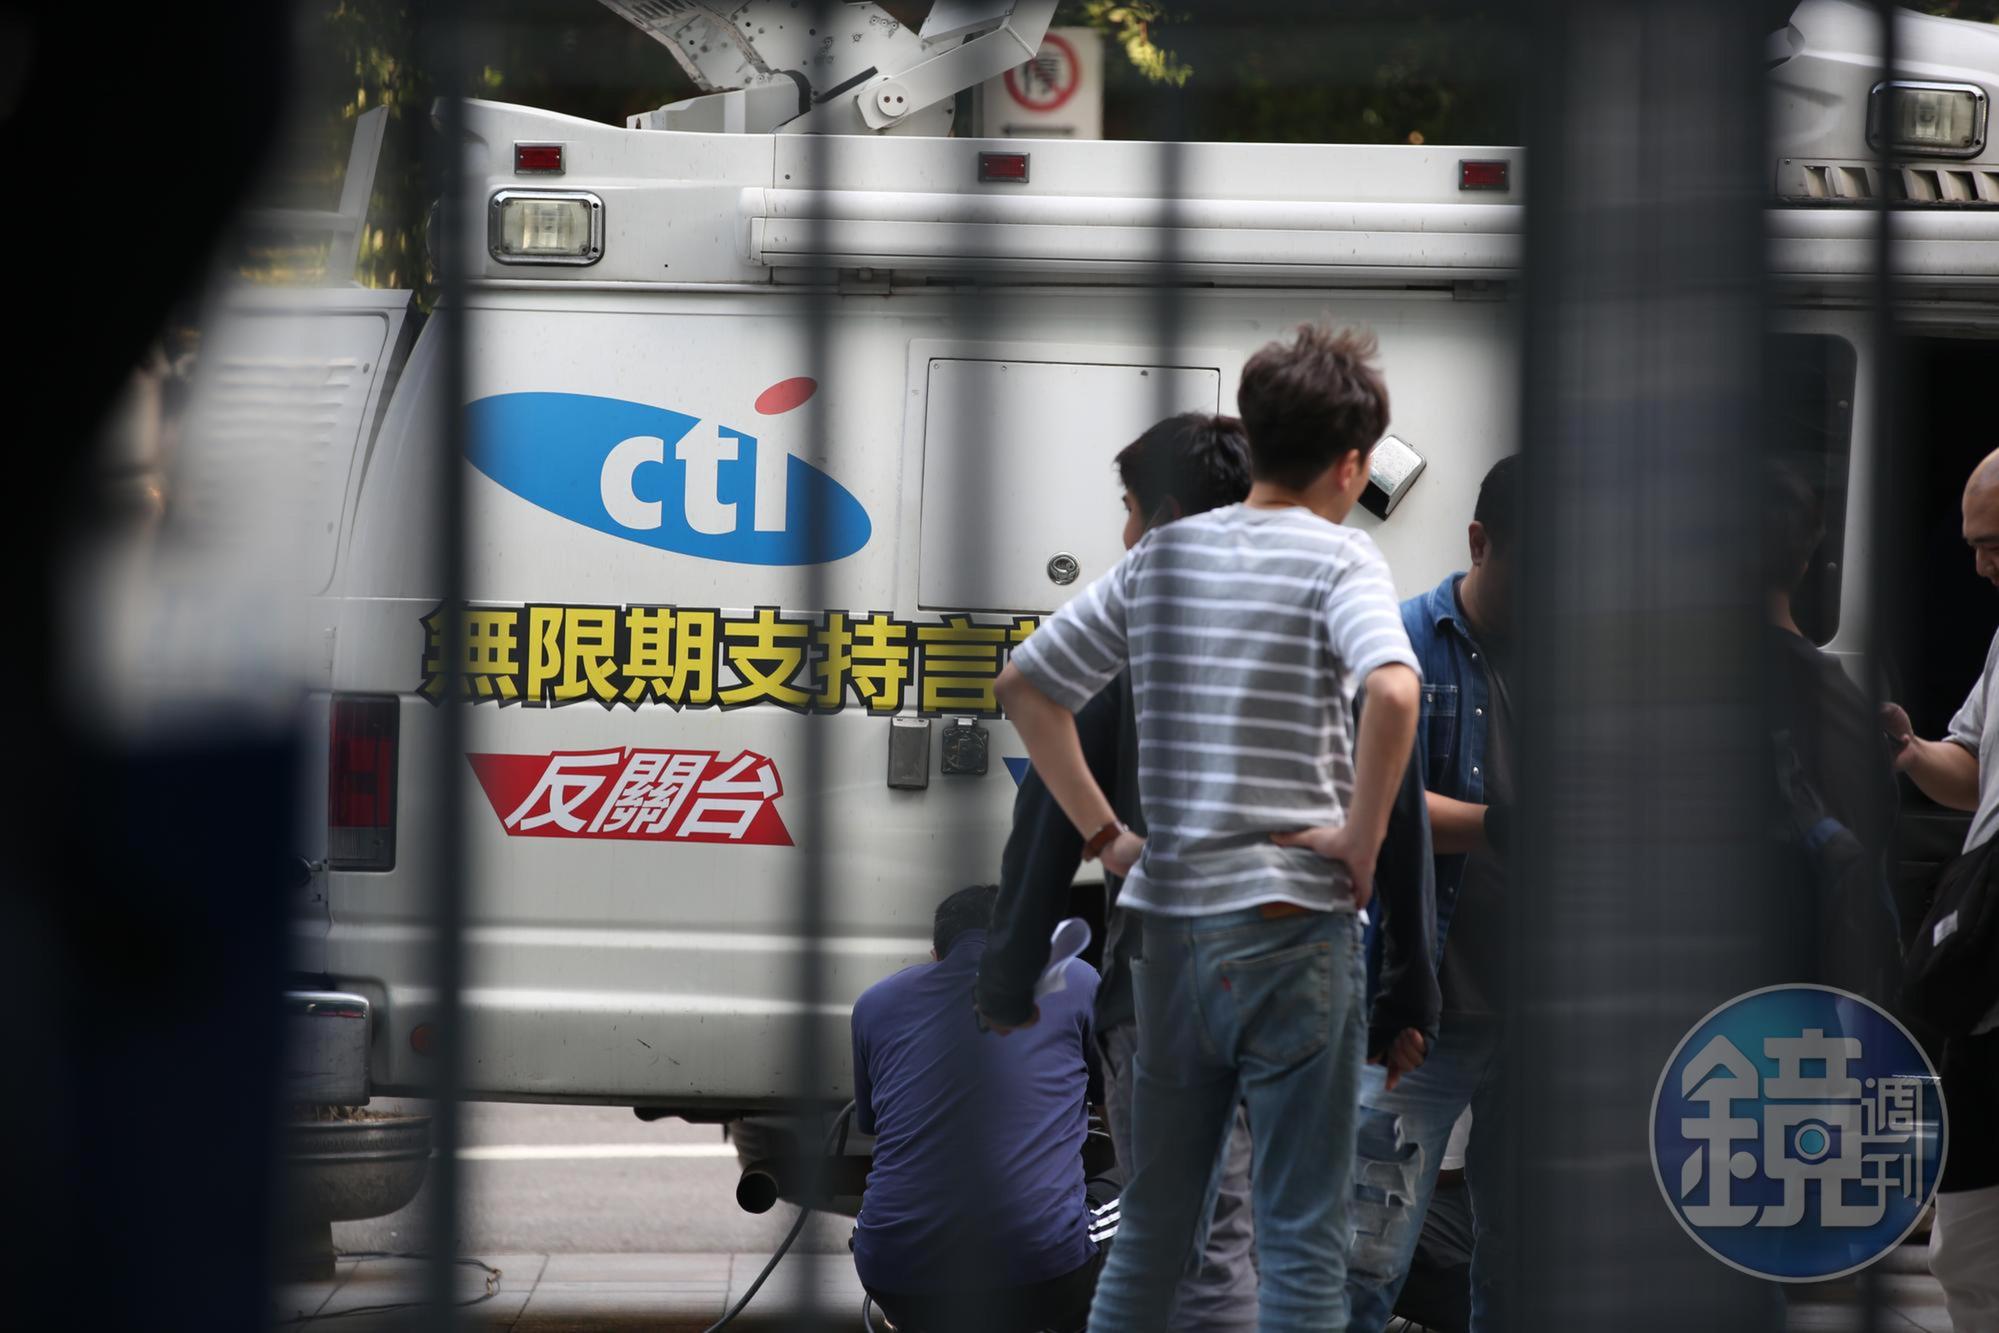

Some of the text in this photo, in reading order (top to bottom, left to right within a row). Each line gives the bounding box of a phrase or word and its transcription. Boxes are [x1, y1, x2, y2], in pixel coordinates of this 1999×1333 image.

[600, 377, 818, 535] cti
[424, 607, 1036, 712] 無限期支持言
[504, 752, 778, 839] 反關台
